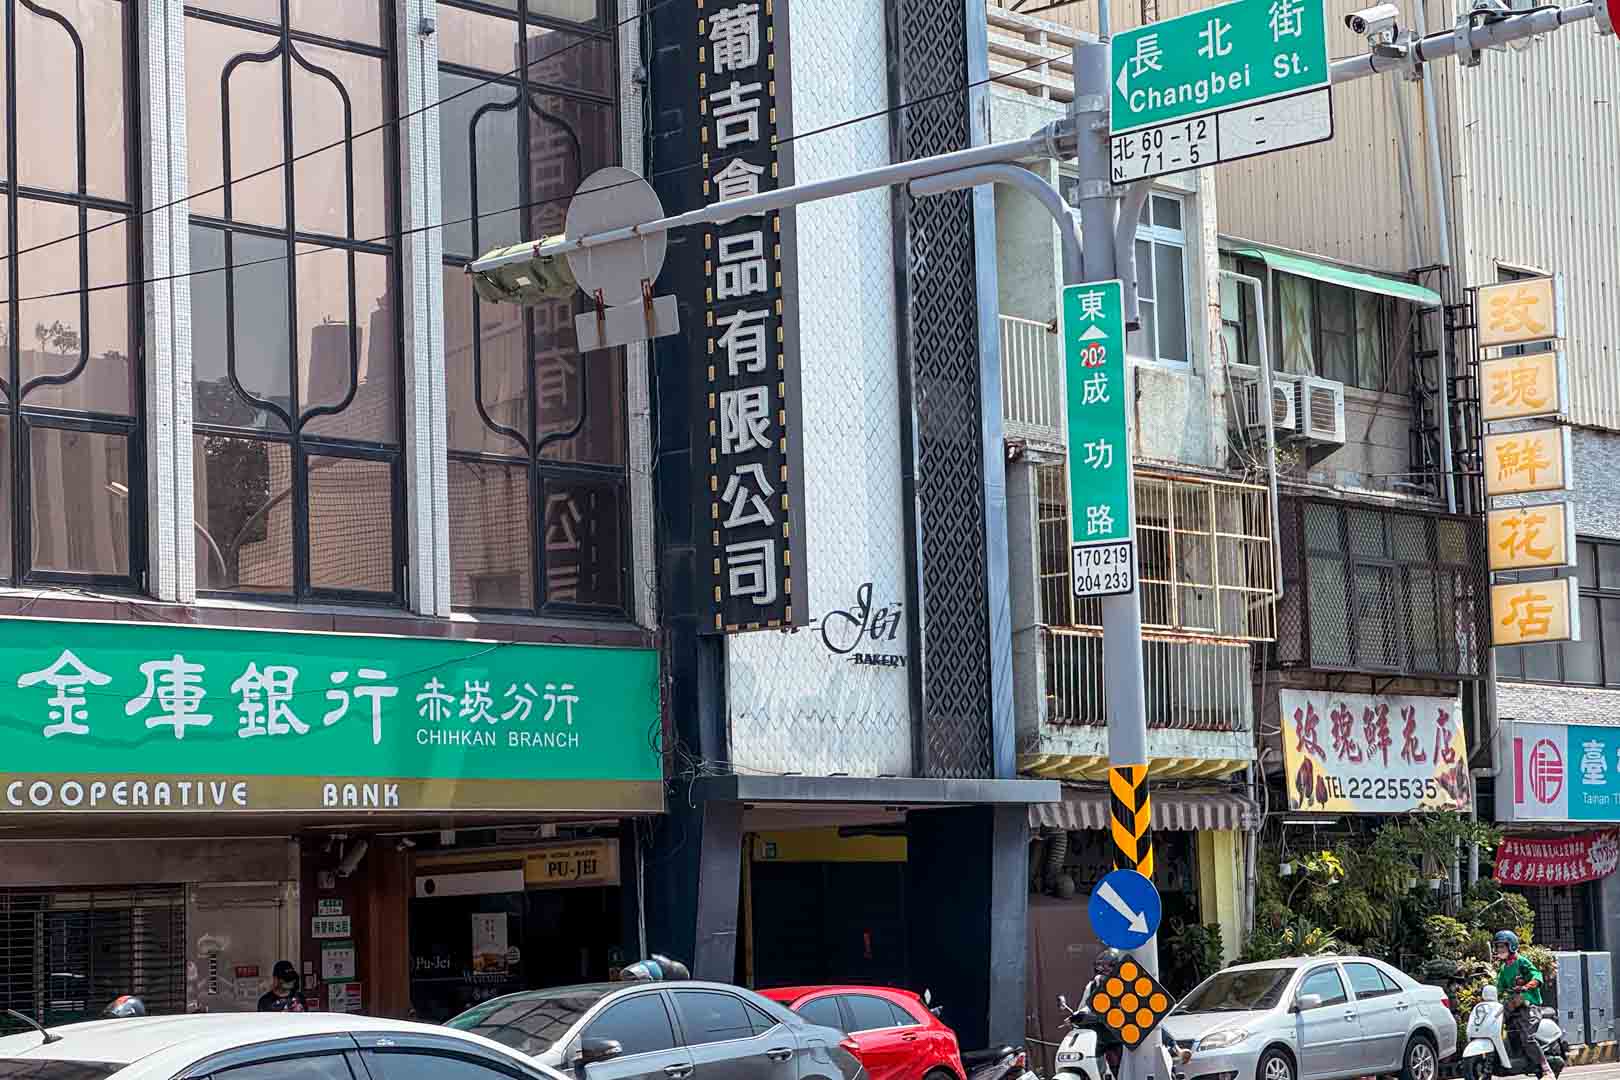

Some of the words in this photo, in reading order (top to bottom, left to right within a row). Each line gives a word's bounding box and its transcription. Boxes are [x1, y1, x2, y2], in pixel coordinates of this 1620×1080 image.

[1129, 0, 1305, 79] 長北街
[1129, 63, 1251, 113] Changbei
[1273, 52, 1310, 79] St.
[1113, 136, 1135, 162] 北
[1113, 167, 1128, 180] N.
[708, 3, 778, 607] 葡吉食品有限公司
[1077, 289, 1106, 321] 東
[1080, 346, 1106, 368] 202
[1081, 372, 1115, 536] 成功路
[1488, 288, 1554, 638] 玫瑰鮮花店
[1077, 551, 1101, 567] 170
[1103, 547, 1128, 565] 219
[1077, 574, 1101, 592] 204
[1104, 571, 1129, 590] 233
[820, 583, 902, 654] Jei
[853, 652, 907, 668] BAKERY
[17, 649, 399, 745] 金庫銀行
[416, 676, 579, 725] 赤崁分行
[416, 728, 497, 747] CHIHKAN
[508, 731, 579, 748] BRANCH
[1294, 701, 1457, 768] 玫瑰鮮花店
[6, 780, 249, 807] COOPERATIVE
[323, 782, 399, 807] BANK
[1325, 775, 1345, 799] TEL
[1348, 777, 1438, 800] 2225535
[547, 859, 598, 880] PU-JEI
